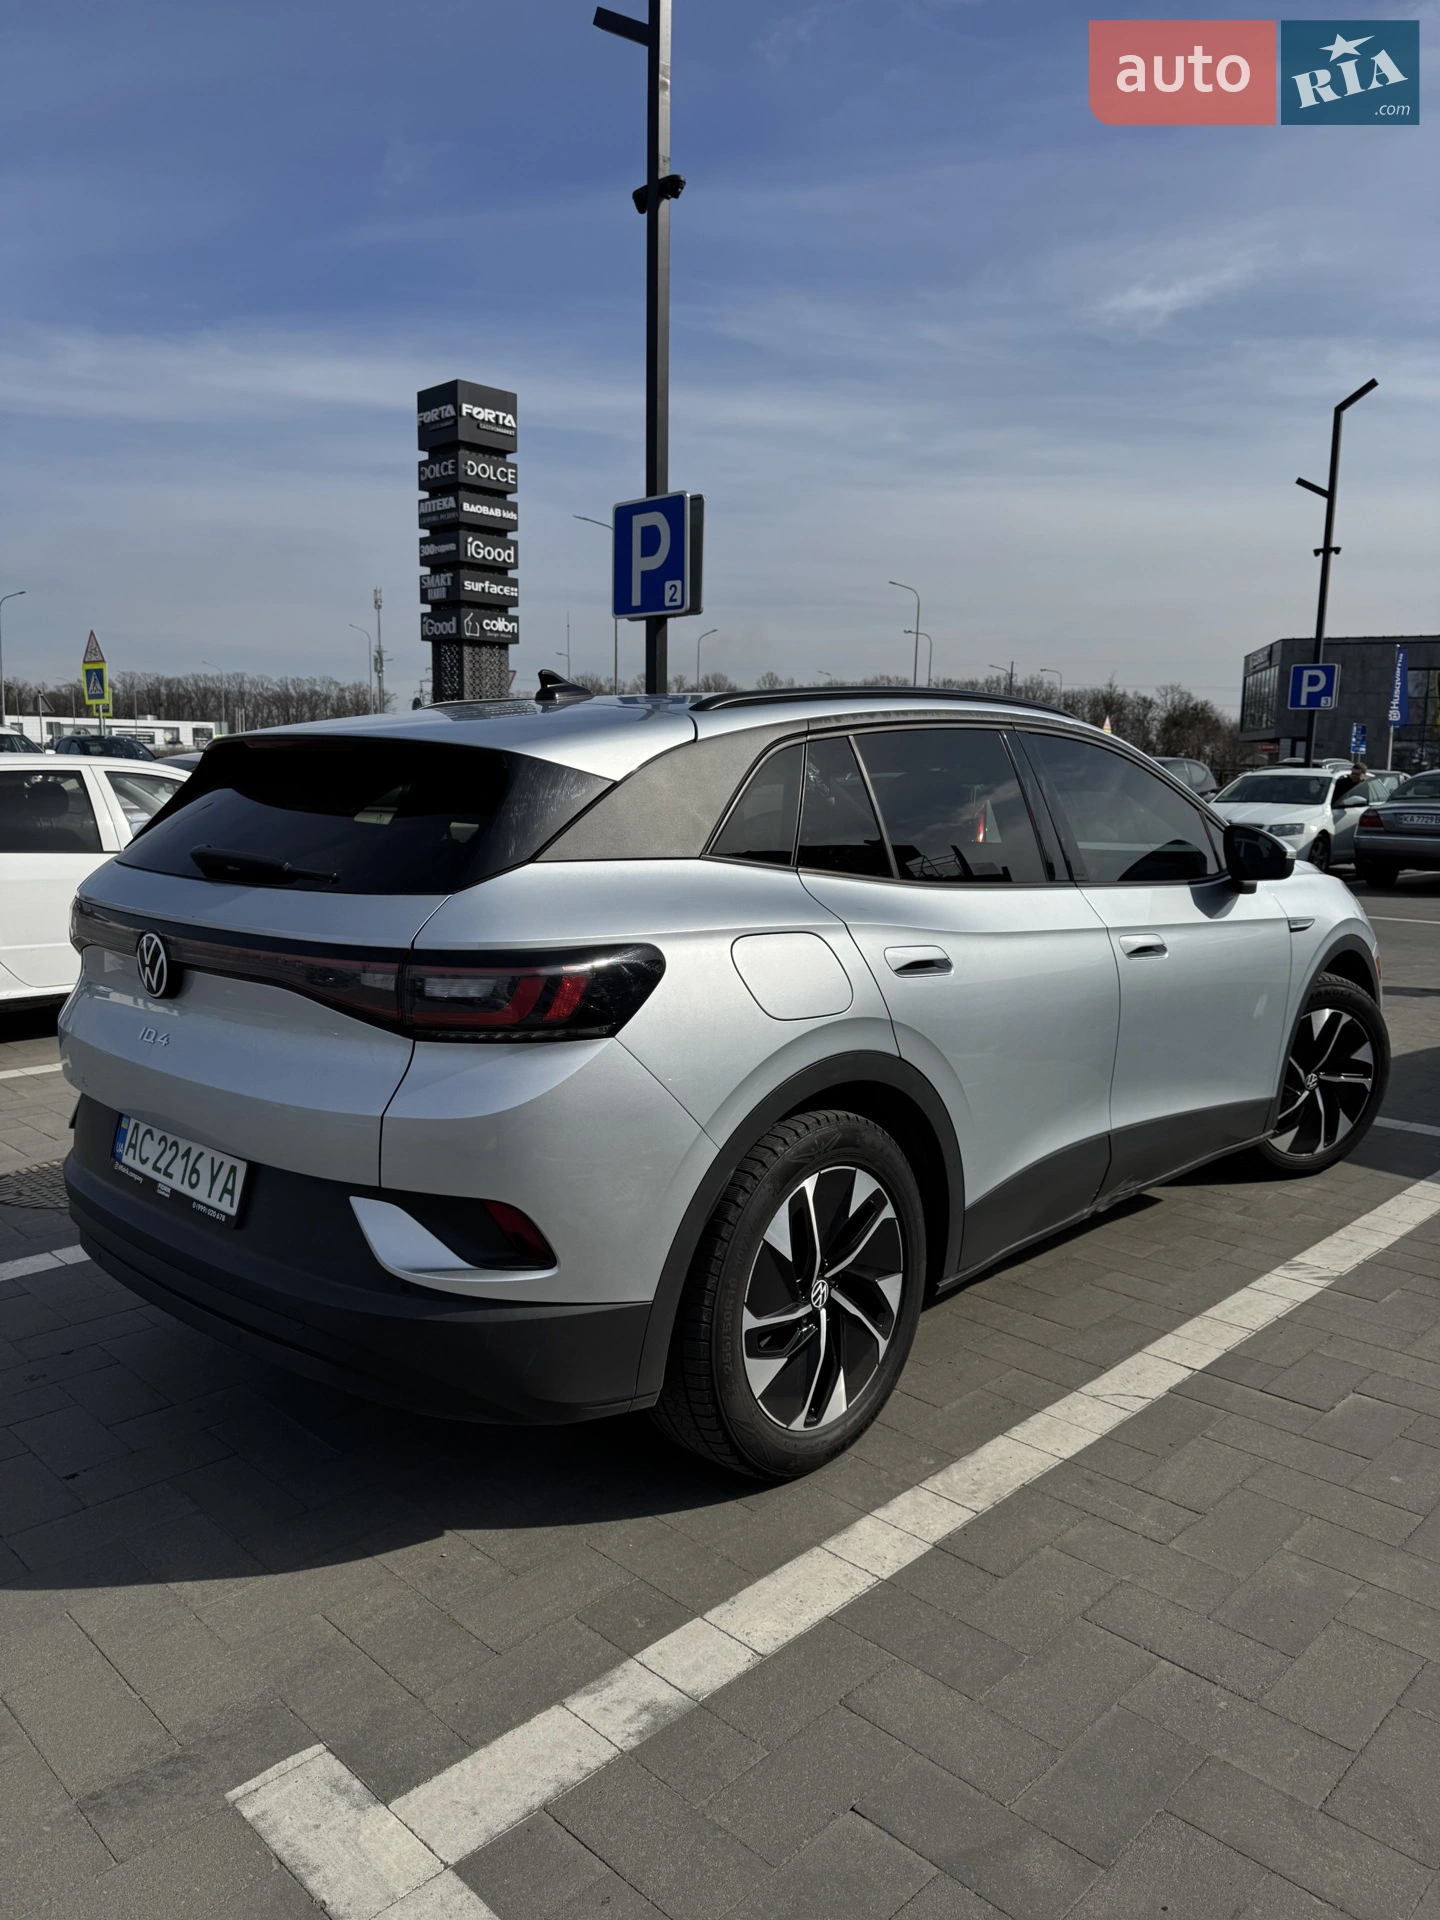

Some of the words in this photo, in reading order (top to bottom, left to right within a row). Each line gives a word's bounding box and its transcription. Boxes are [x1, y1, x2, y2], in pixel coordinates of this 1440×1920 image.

[420, 459, 456, 481] DOLCE
[467, 460, 516, 484] DOLCE
[463, 502, 502, 518] BAOBAB
[502, 506, 518, 521] kids
[467, 536, 514, 563] iGood
[631, 511, 671, 607] P
[421, 572, 453, 589] SMART
[668, 584, 678, 602] 2
[422, 616, 457, 636] iGood
[1300, 669, 1327, 706] P
